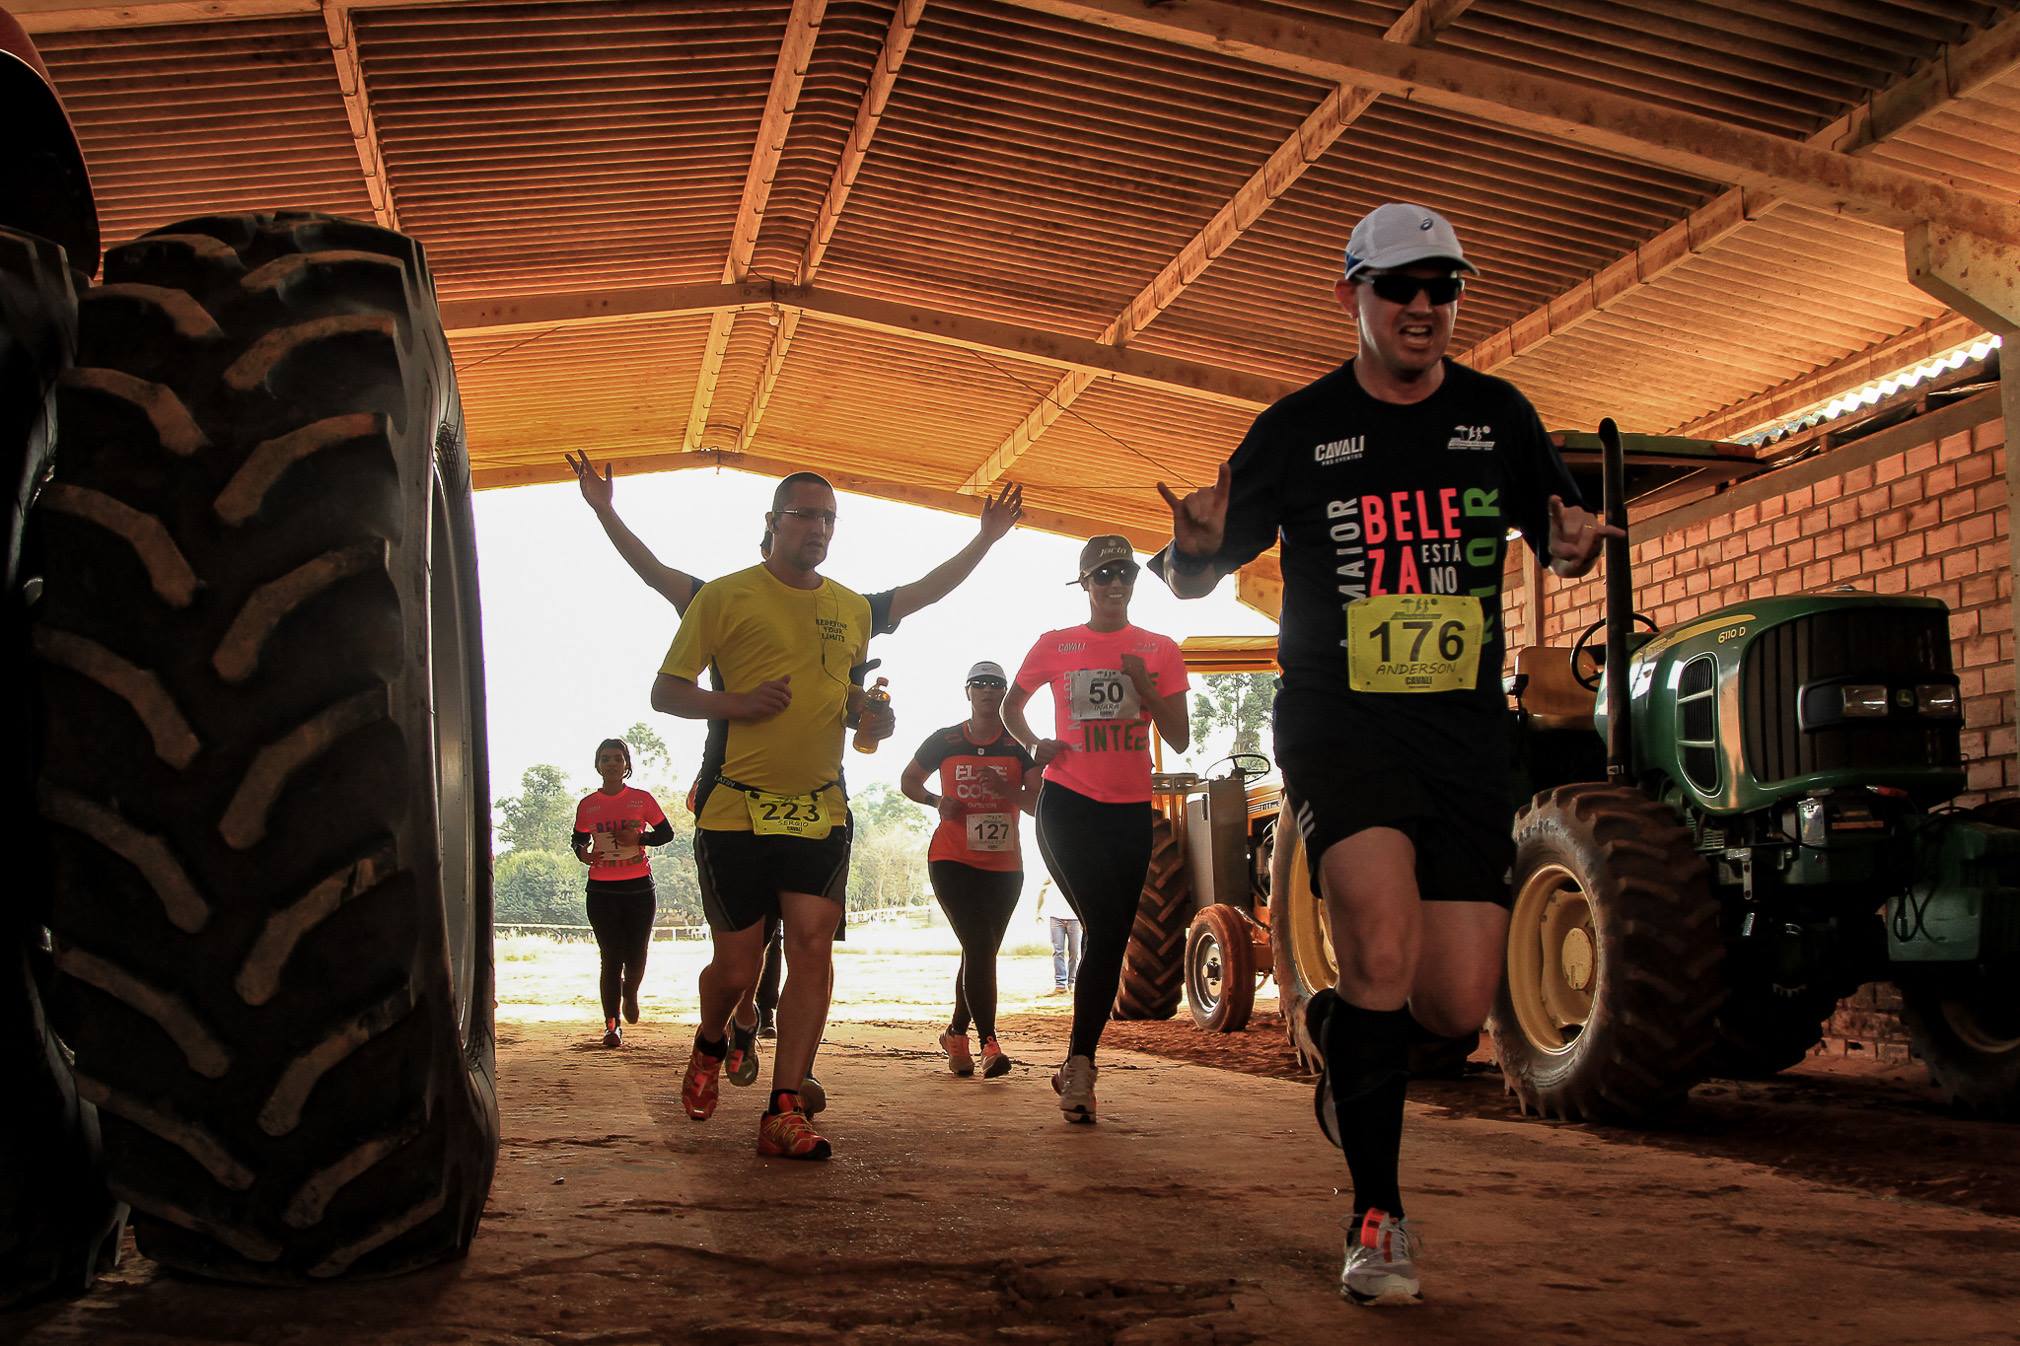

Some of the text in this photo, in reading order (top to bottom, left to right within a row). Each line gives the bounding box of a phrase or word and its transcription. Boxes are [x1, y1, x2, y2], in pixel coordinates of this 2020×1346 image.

[1315, 435, 1365, 462] CAVALI
[1361, 487, 1462, 545] BELE
[1421, 540, 1462, 563] ESTÁ
[1368, 545, 1423, 597] ZA
[1430, 566, 1458, 594] NO
[1369, 620, 1466, 663] 176
[1718, 627, 1746, 643] 6110 D
[1375, 662, 1458, 675] ANDERSON
[1089, 682, 1124, 705] 50
[759, 802, 820, 822] 223
[974, 823, 1009, 841] 127
